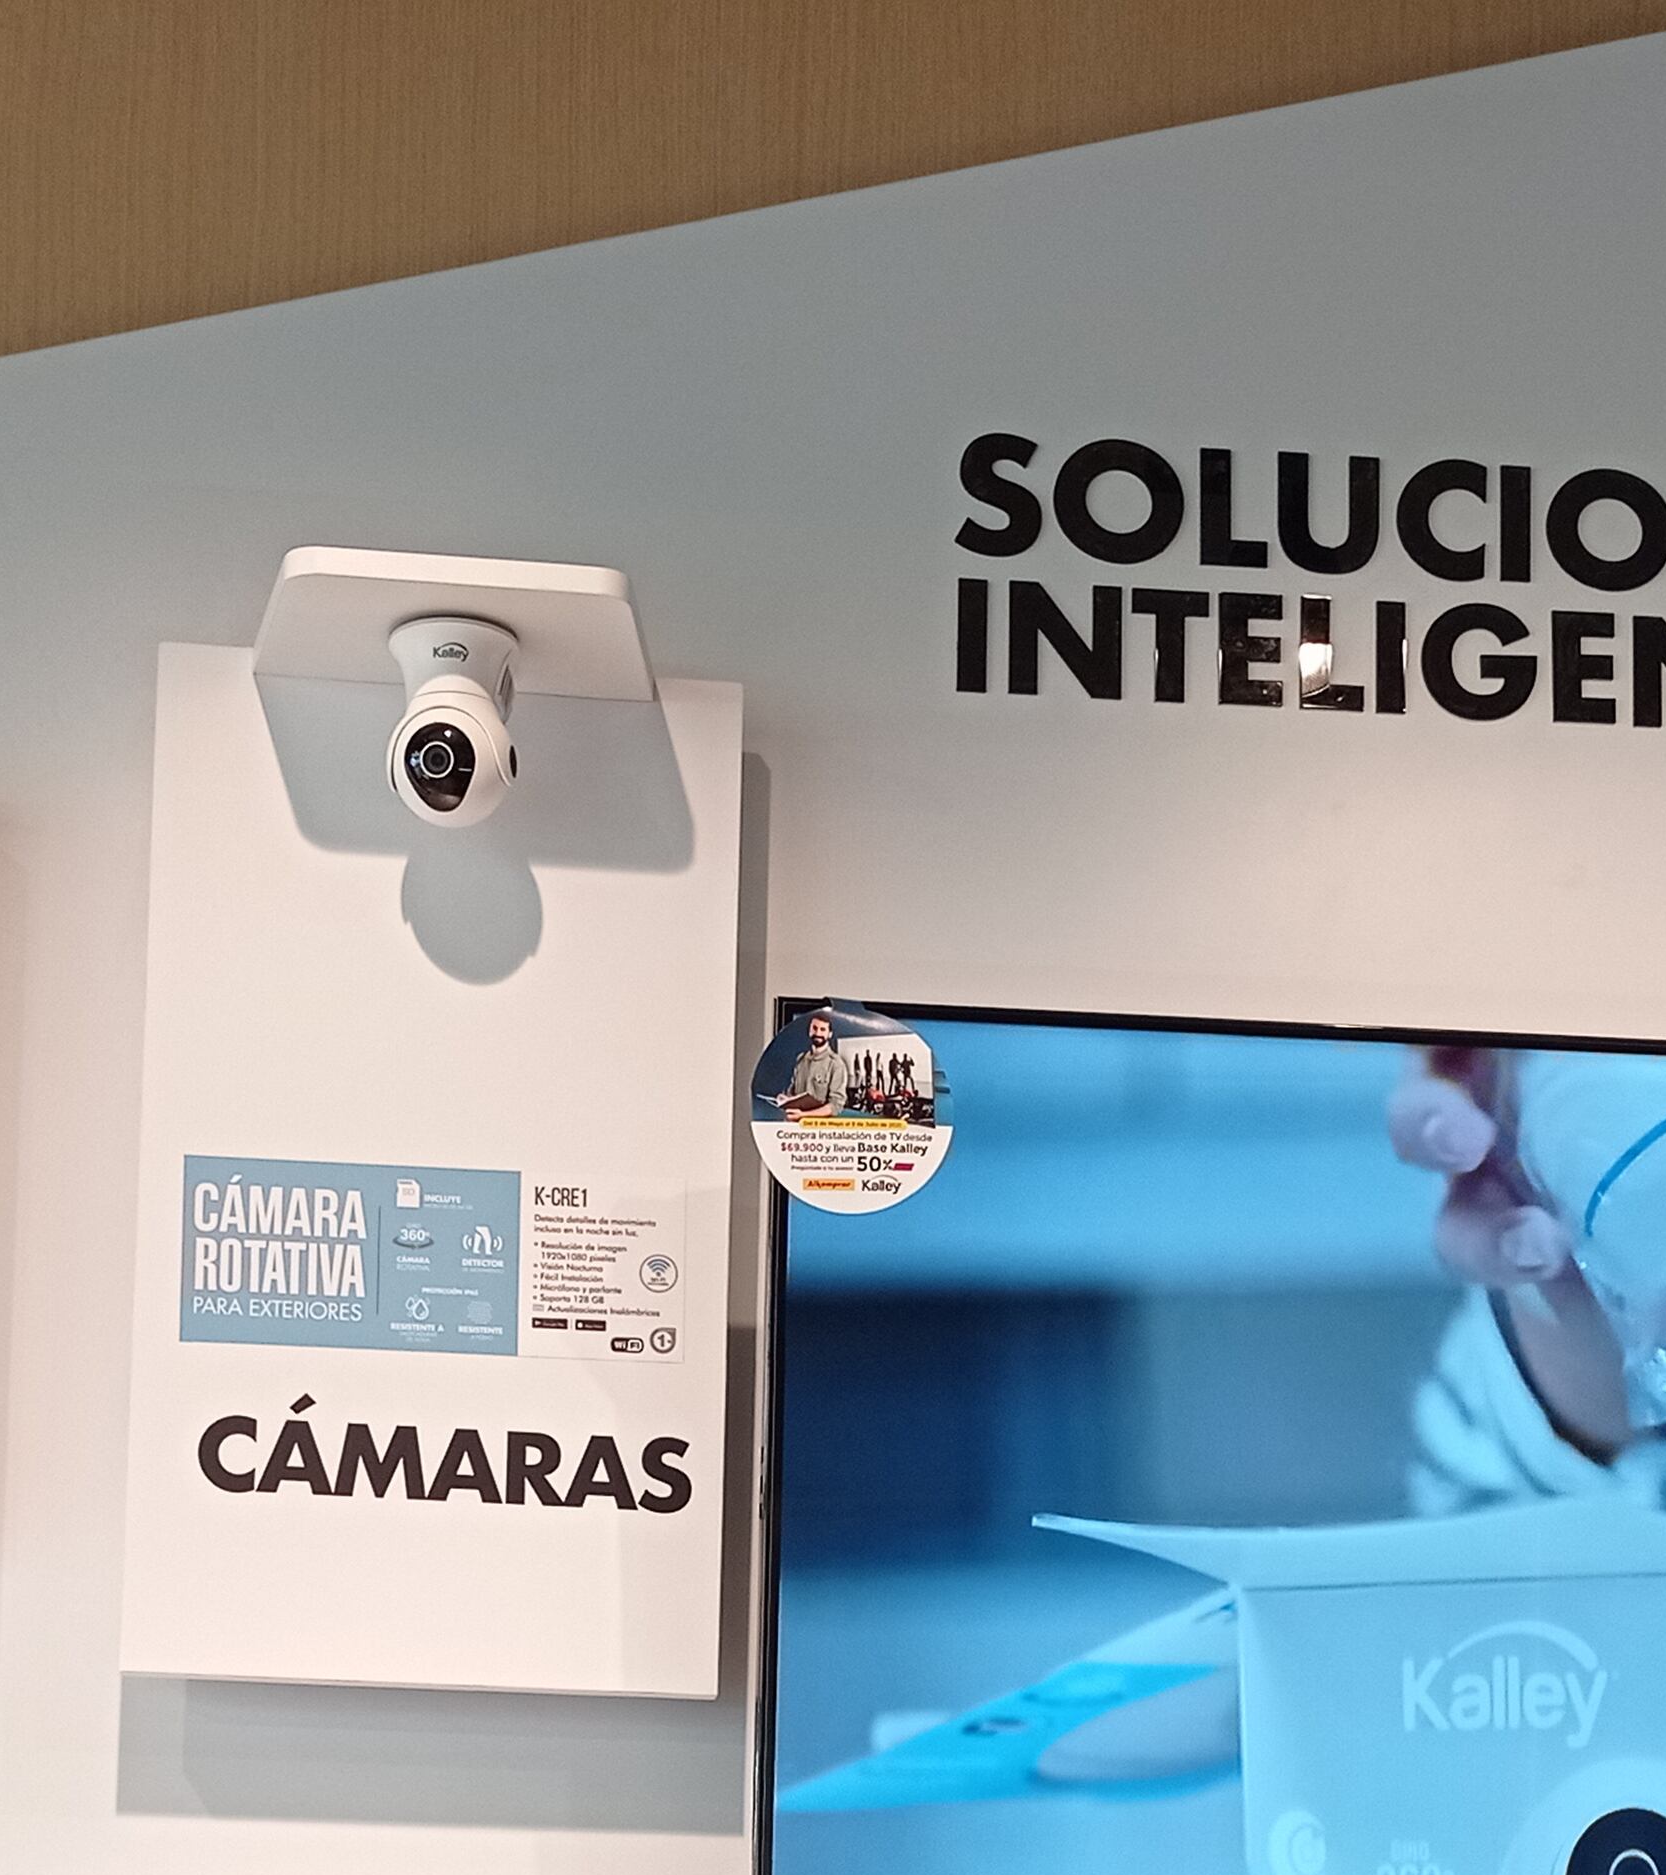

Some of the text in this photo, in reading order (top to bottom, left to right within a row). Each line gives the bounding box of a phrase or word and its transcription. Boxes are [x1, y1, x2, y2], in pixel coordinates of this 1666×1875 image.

[433, 644, 469, 662] Kalley
[776, 1129, 816, 1141] Compra
[874, 1131, 886, 1141] de
[889, 1132, 902, 1141] TV
[903, 1132, 932, 1142] desde
[857, 1142, 887, 1154] Base
[890, 1143, 928, 1156] Kalley
[791, 1154, 818, 1163] hasta
[820, 1156, 838, 1164] con
[840, 1156, 854, 1164] un
[857, 1156, 893, 1172] 50%
[533, 1185, 588, 1208] K-CRE1
[861, 1178, 902, 1195] Kalley
[192, 1174, 367, 1240] CÁMARA
[193, 1236, 366, 1298] ROTATIVA
[461, 1258, 504, 1269] DETECTOR
[192, 1296, 363, 1322] PARA EXTERIORES
[197, 1392, 693, 1514] CÁMARAS
[1402, 1652, 1608, 1747] Kalley
